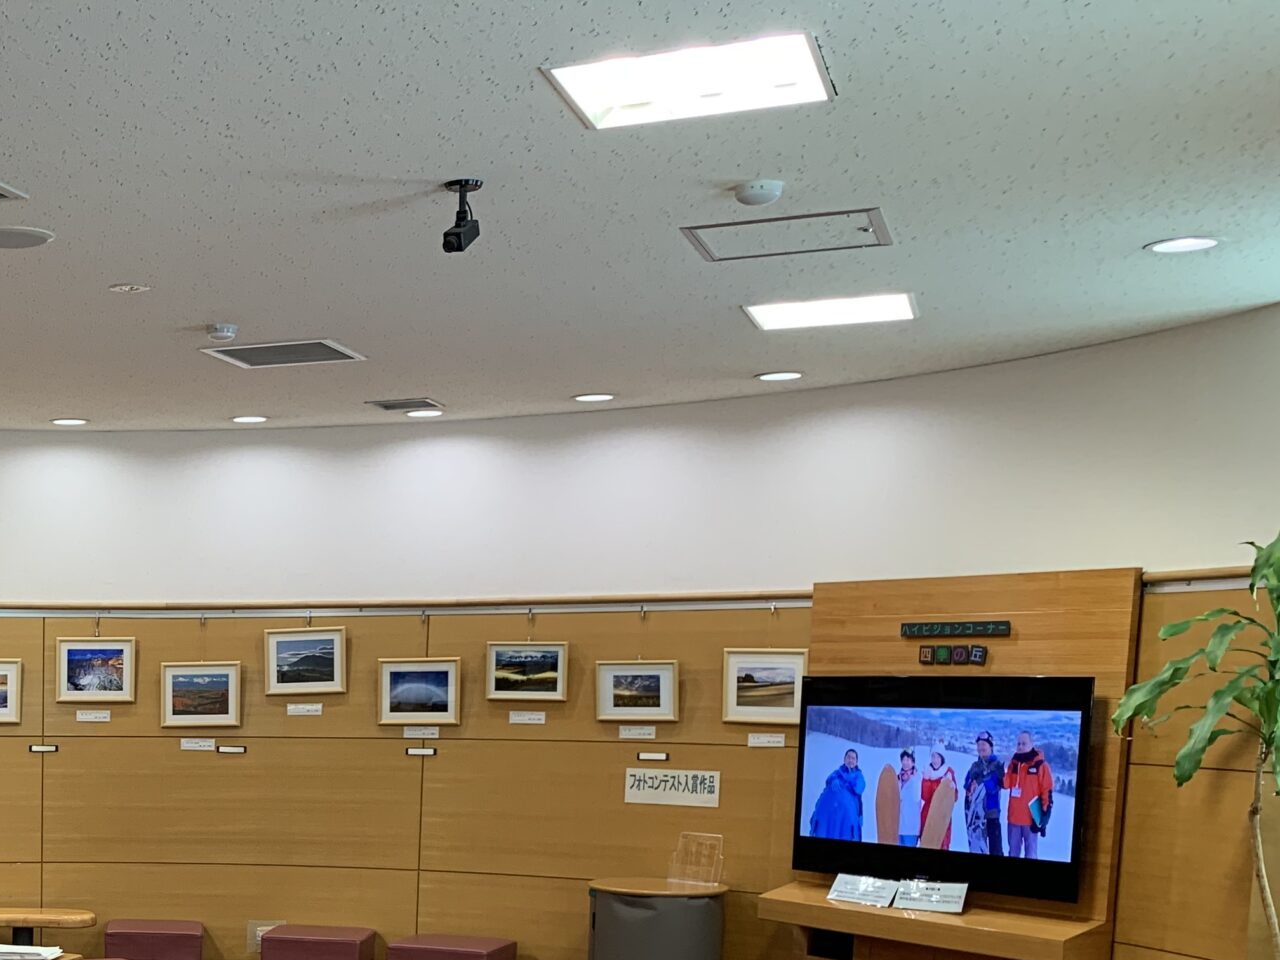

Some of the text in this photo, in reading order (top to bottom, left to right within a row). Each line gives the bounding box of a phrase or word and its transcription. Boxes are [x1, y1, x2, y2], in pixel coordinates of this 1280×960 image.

[902, 623, 1007, 635] ハイビジョンコーナー
[920, 647, 984, 662] 四季の丘
[629, 773, 716, 795] フォトコンテスト入賞作品
